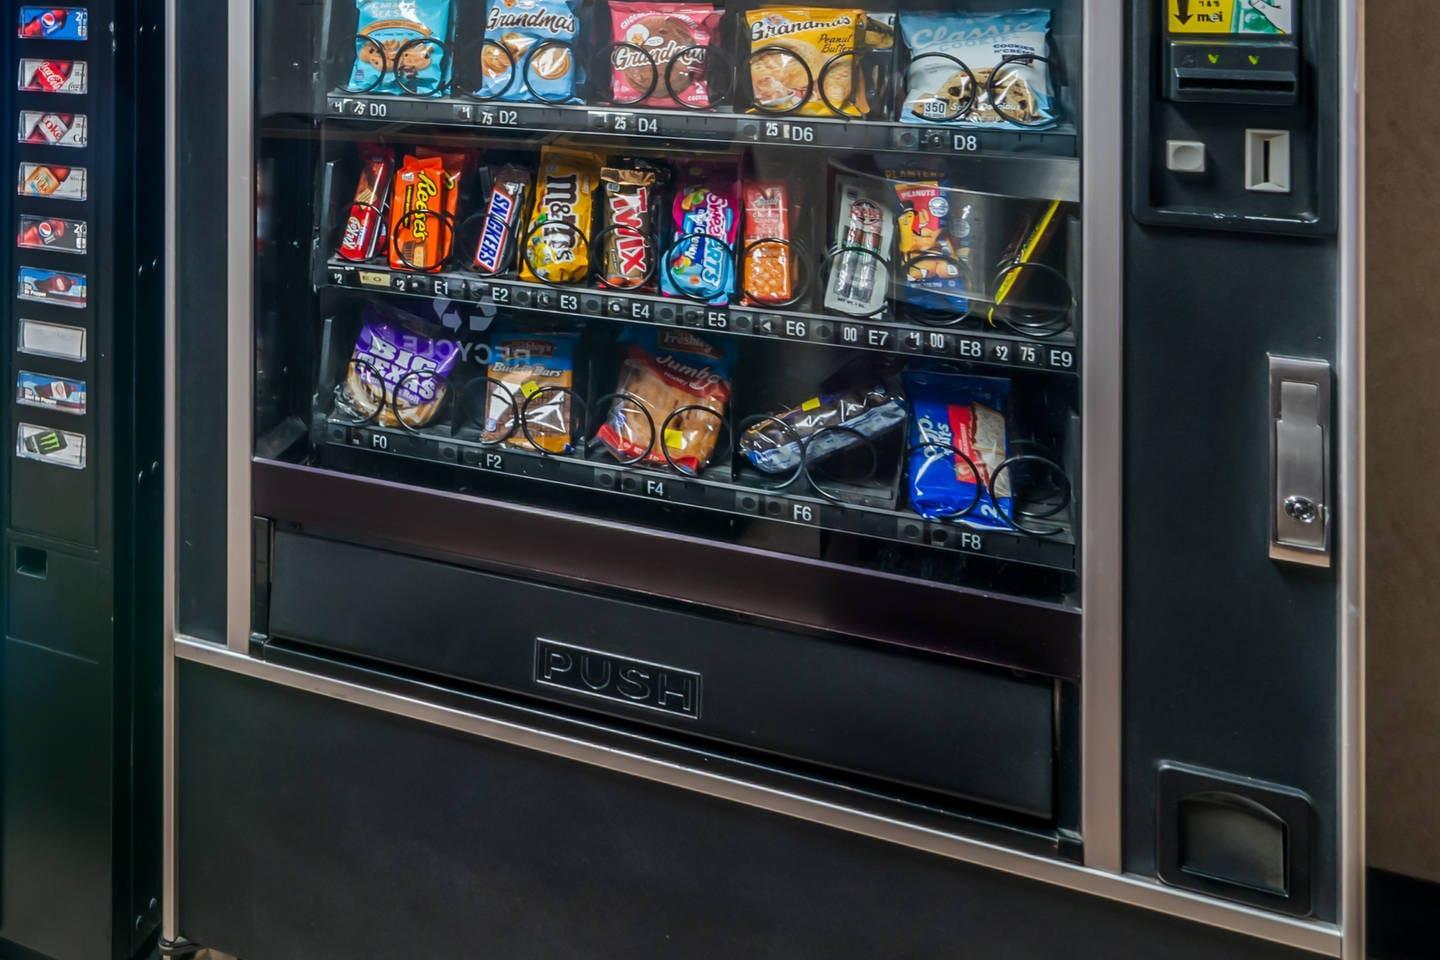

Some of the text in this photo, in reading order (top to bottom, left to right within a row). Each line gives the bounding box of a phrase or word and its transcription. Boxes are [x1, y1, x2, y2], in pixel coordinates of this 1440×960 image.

[486, 7, 576, 33] Grandma's
[1197, 11, 1223, 23] mei
[911, 21, 1033, 51] Classic
[925, 102, 946, 113] 350
[481, 111, 517, 125] 75 D2
[614, 117, 658, 133] 25 D4
[766, 123, 814, 142] 25 D6
[954, 135, 977, 151] D8
[477, 192, 511, 269] SNICKERS
[434, 281, 449, 294] E1
[492, 288, 508, 302] E2
[560, 295, 578, 309] E3
[632, 304, 650, 319] E4
[708, 313, 727, 328] E5
[786, 322, 806, 337] E6
[844, 327, 889, 346] 00 E7
[930, 334, 981, 357] 00 E8
[368, 335, 438, 379] BIG
[1020, 347, 1035, 362] 75
[1050, 352, 1073, 367] E9
[656, 355, 720, 390] Jumbo
[373, 435, 388, 449] F0
[486, 454, 502, 470] F2
[647, 480, 664, 496] F4
[793, 504, 811, 521] F6
[961, 533, 981, 550] F8
[543, 647, 692, 712] PUSH
